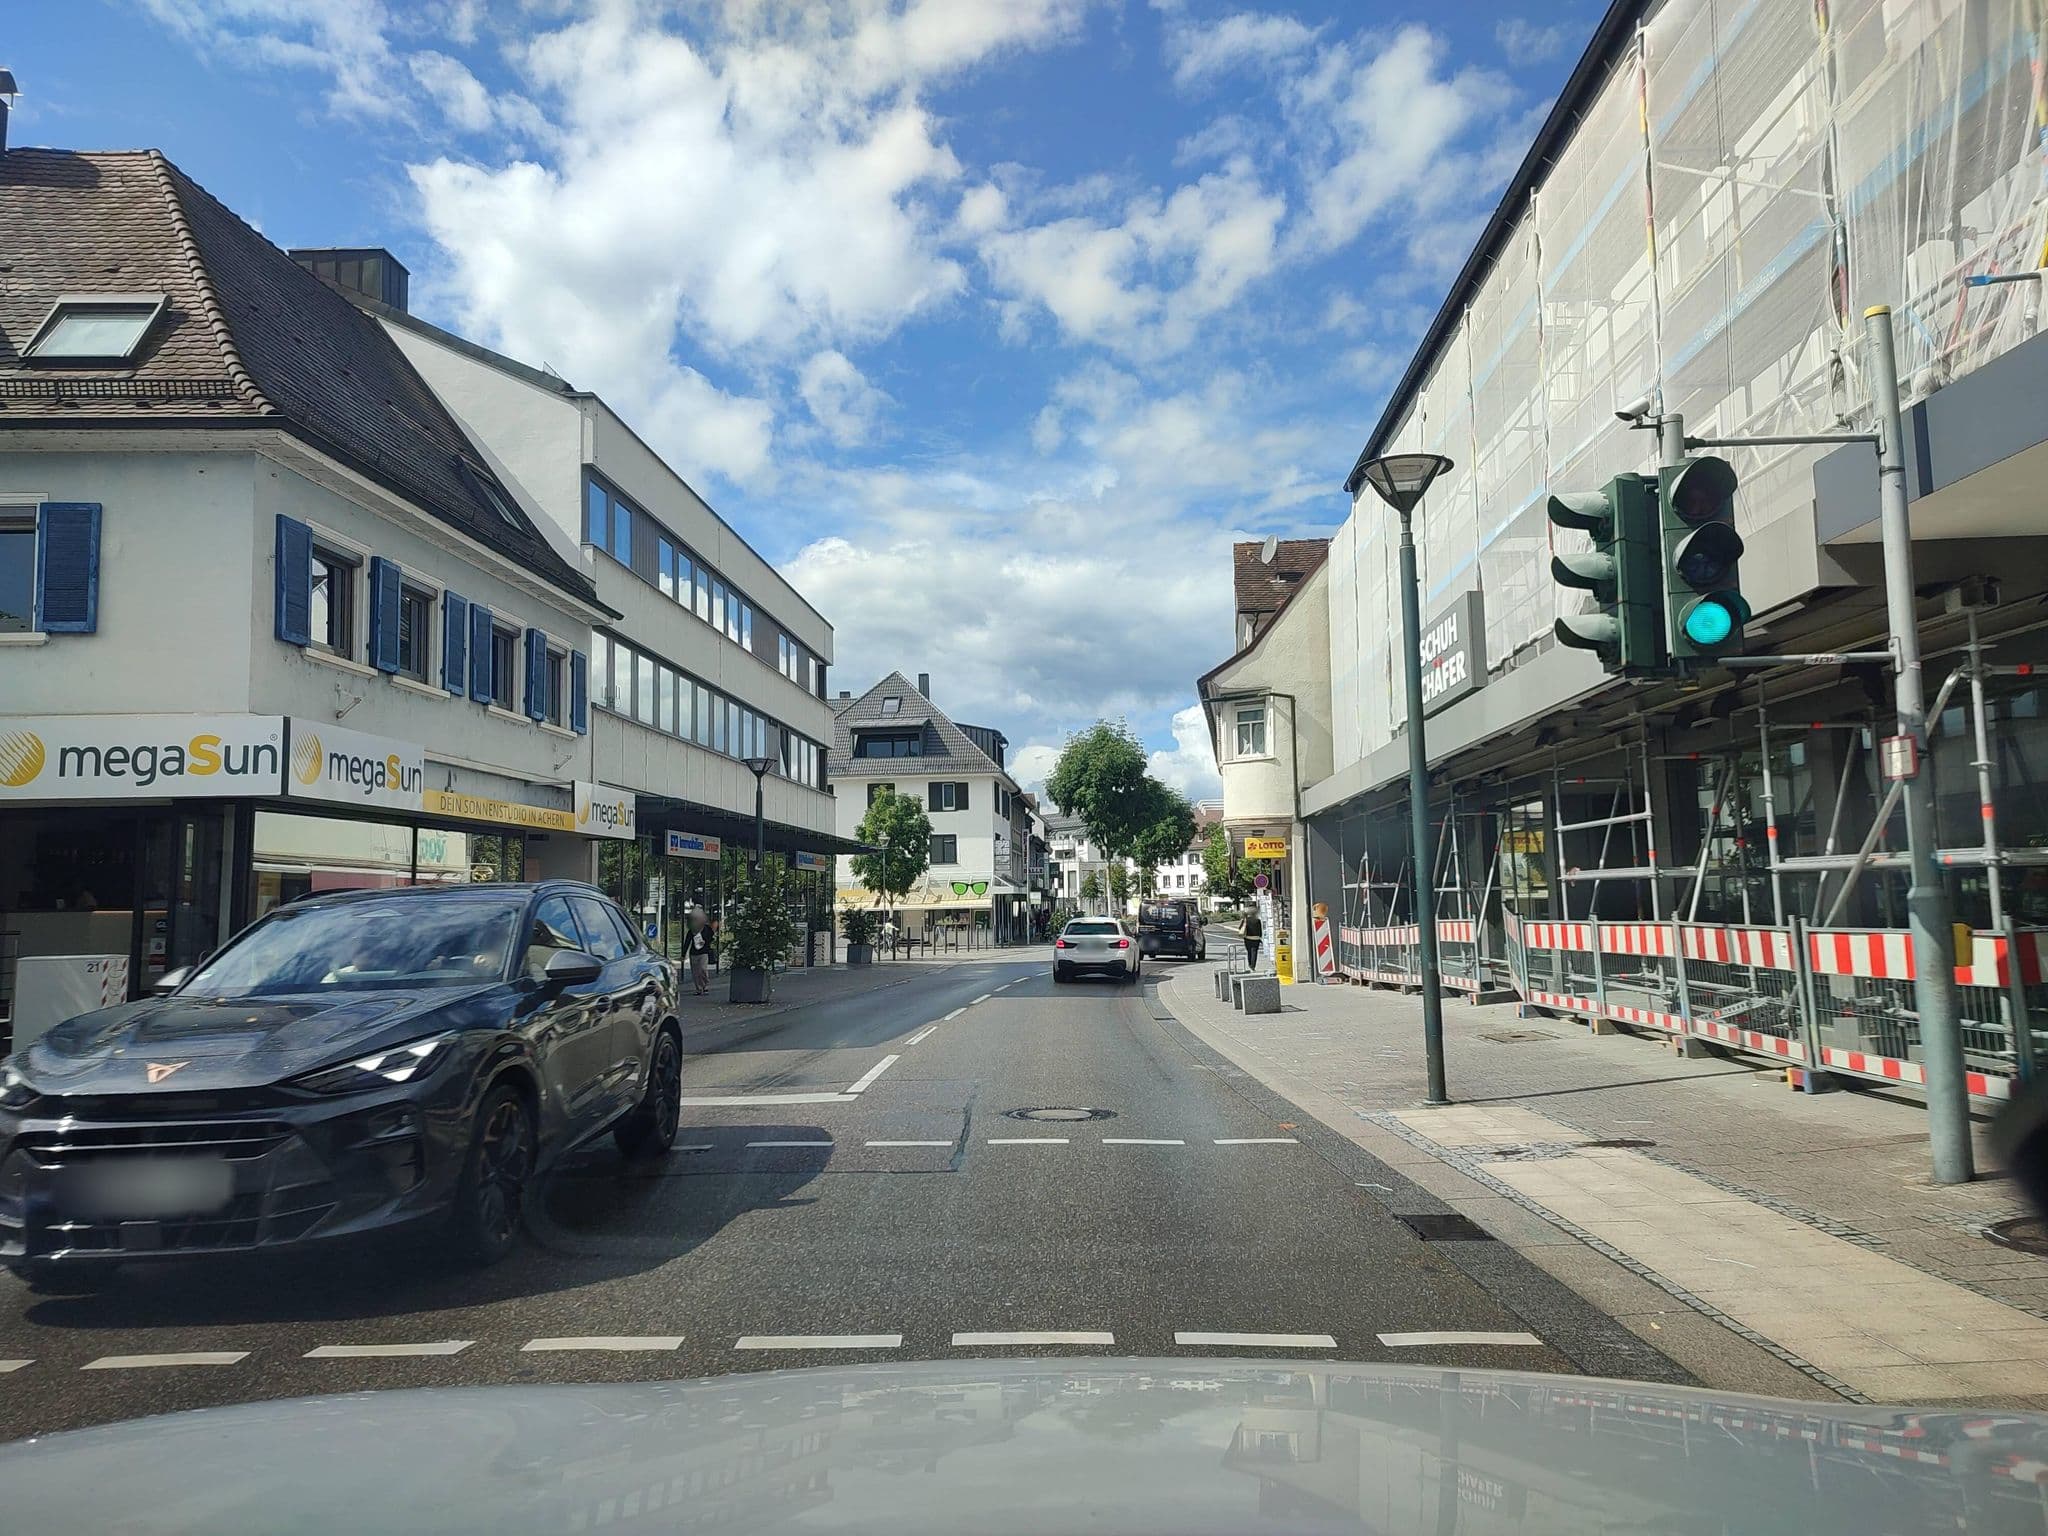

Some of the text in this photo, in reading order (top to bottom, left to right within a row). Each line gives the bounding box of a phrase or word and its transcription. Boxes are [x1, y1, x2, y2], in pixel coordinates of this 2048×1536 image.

[1420, 612, 1458, 667] SCHUH
[1421, 651, 1467, 704] CHÄFER
[58, 734, 278, 787] megaSun
[328, 752, 422, 795] megaSun
[440, 795, 565, 827] DEIN SONNENSTUDIO IN ACHERN
[591, 800, 635, 830] megaSun
[1258, 841, 1285, 850] LOTTO
[87, 963, 100, 973] 21
